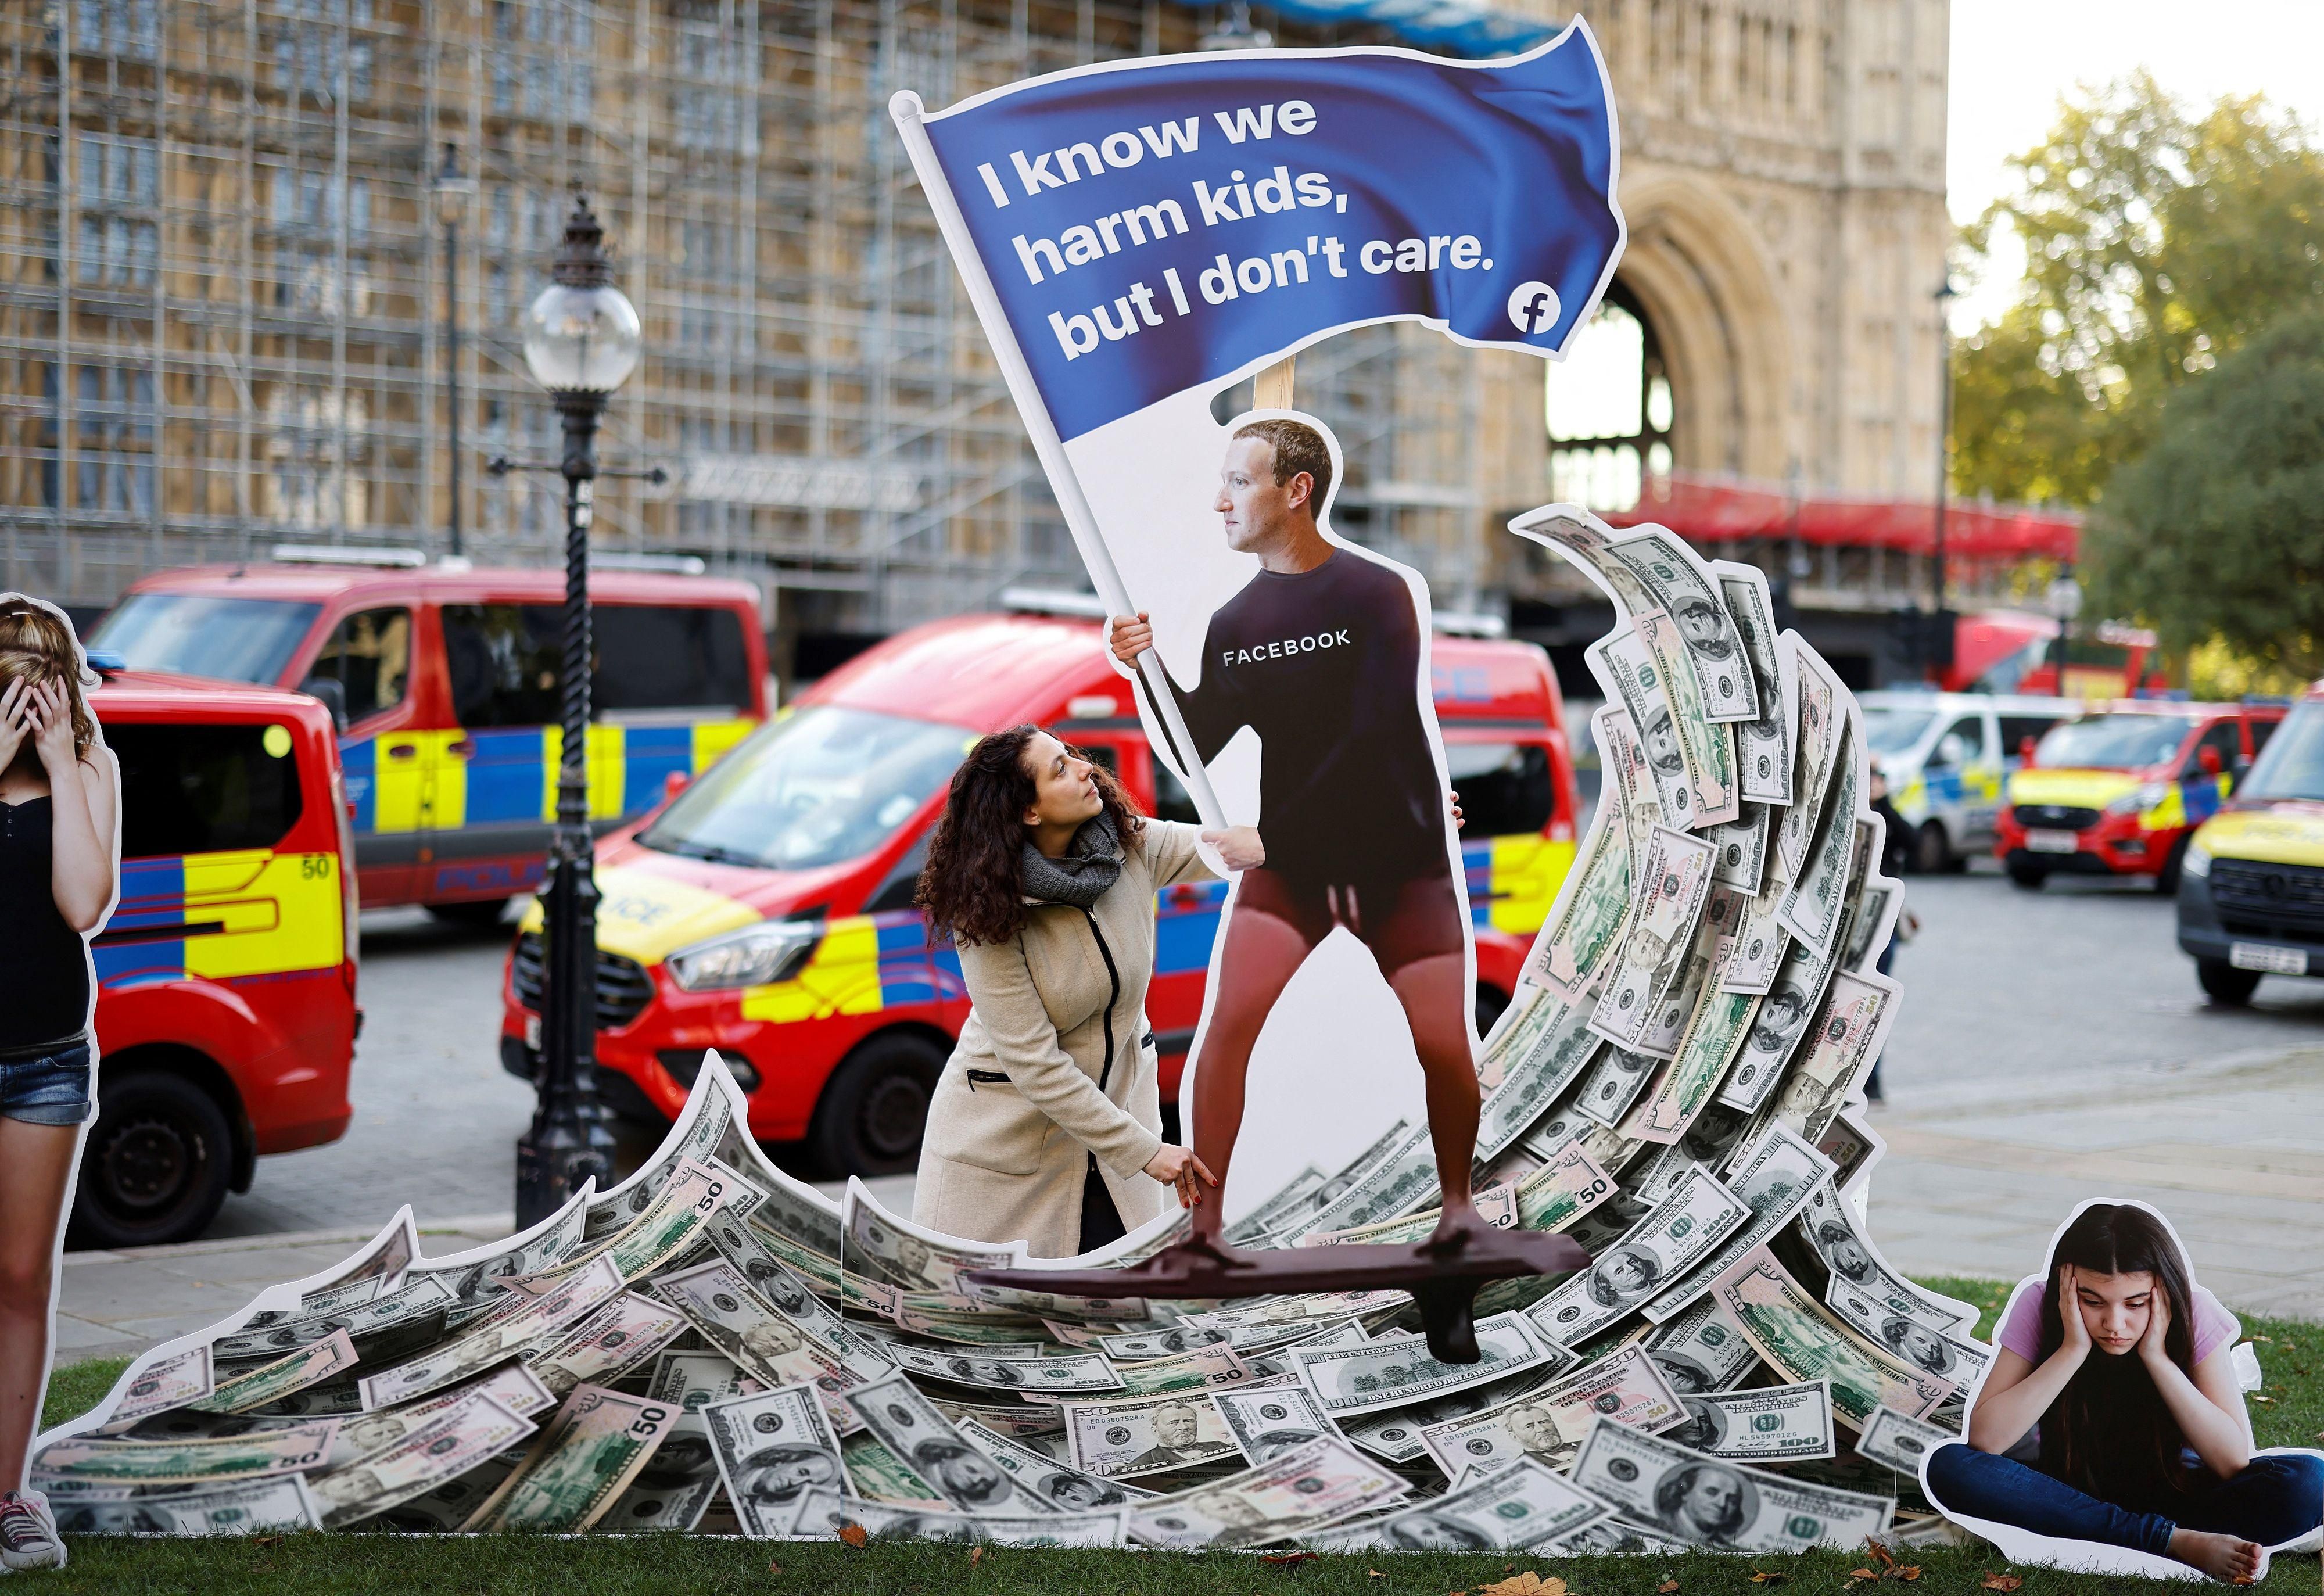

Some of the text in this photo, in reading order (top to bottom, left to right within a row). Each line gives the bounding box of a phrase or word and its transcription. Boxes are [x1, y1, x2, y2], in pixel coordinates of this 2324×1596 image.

[977, 100, 1317, 208] I know we
[1012, 166, 1347, 285] harm kids,
[1048, 282, 1164, 361] but
[1163, 268, 1190, 316] I
[1361, 235, 1493, 274] care.
[1223, 629, 1351, 667] FACEBOOK
[301, 854, 331, 881] 50
[698, 1181, 723, 1212] 50
[1580, 1179, 1607, 1203] 50
[1702, 1209, 1731, 1238] 100
[867, 1300, 895, 1314] 50
[1212, 1369, 1243, 1383] 50
[1368, 1393, 1391, 1401] ONE
[1392, 1380, 1444, 1398] HUNDRED
[1444, 1366, 1495, 1385] DOLLARS
[632, 1407, 666, 1436] 50
[1075, 1407, 1110, 1417] 50
[1647, 1404, 1669, 1419] 50
[1778, 1437, 1819, 1448] 100
